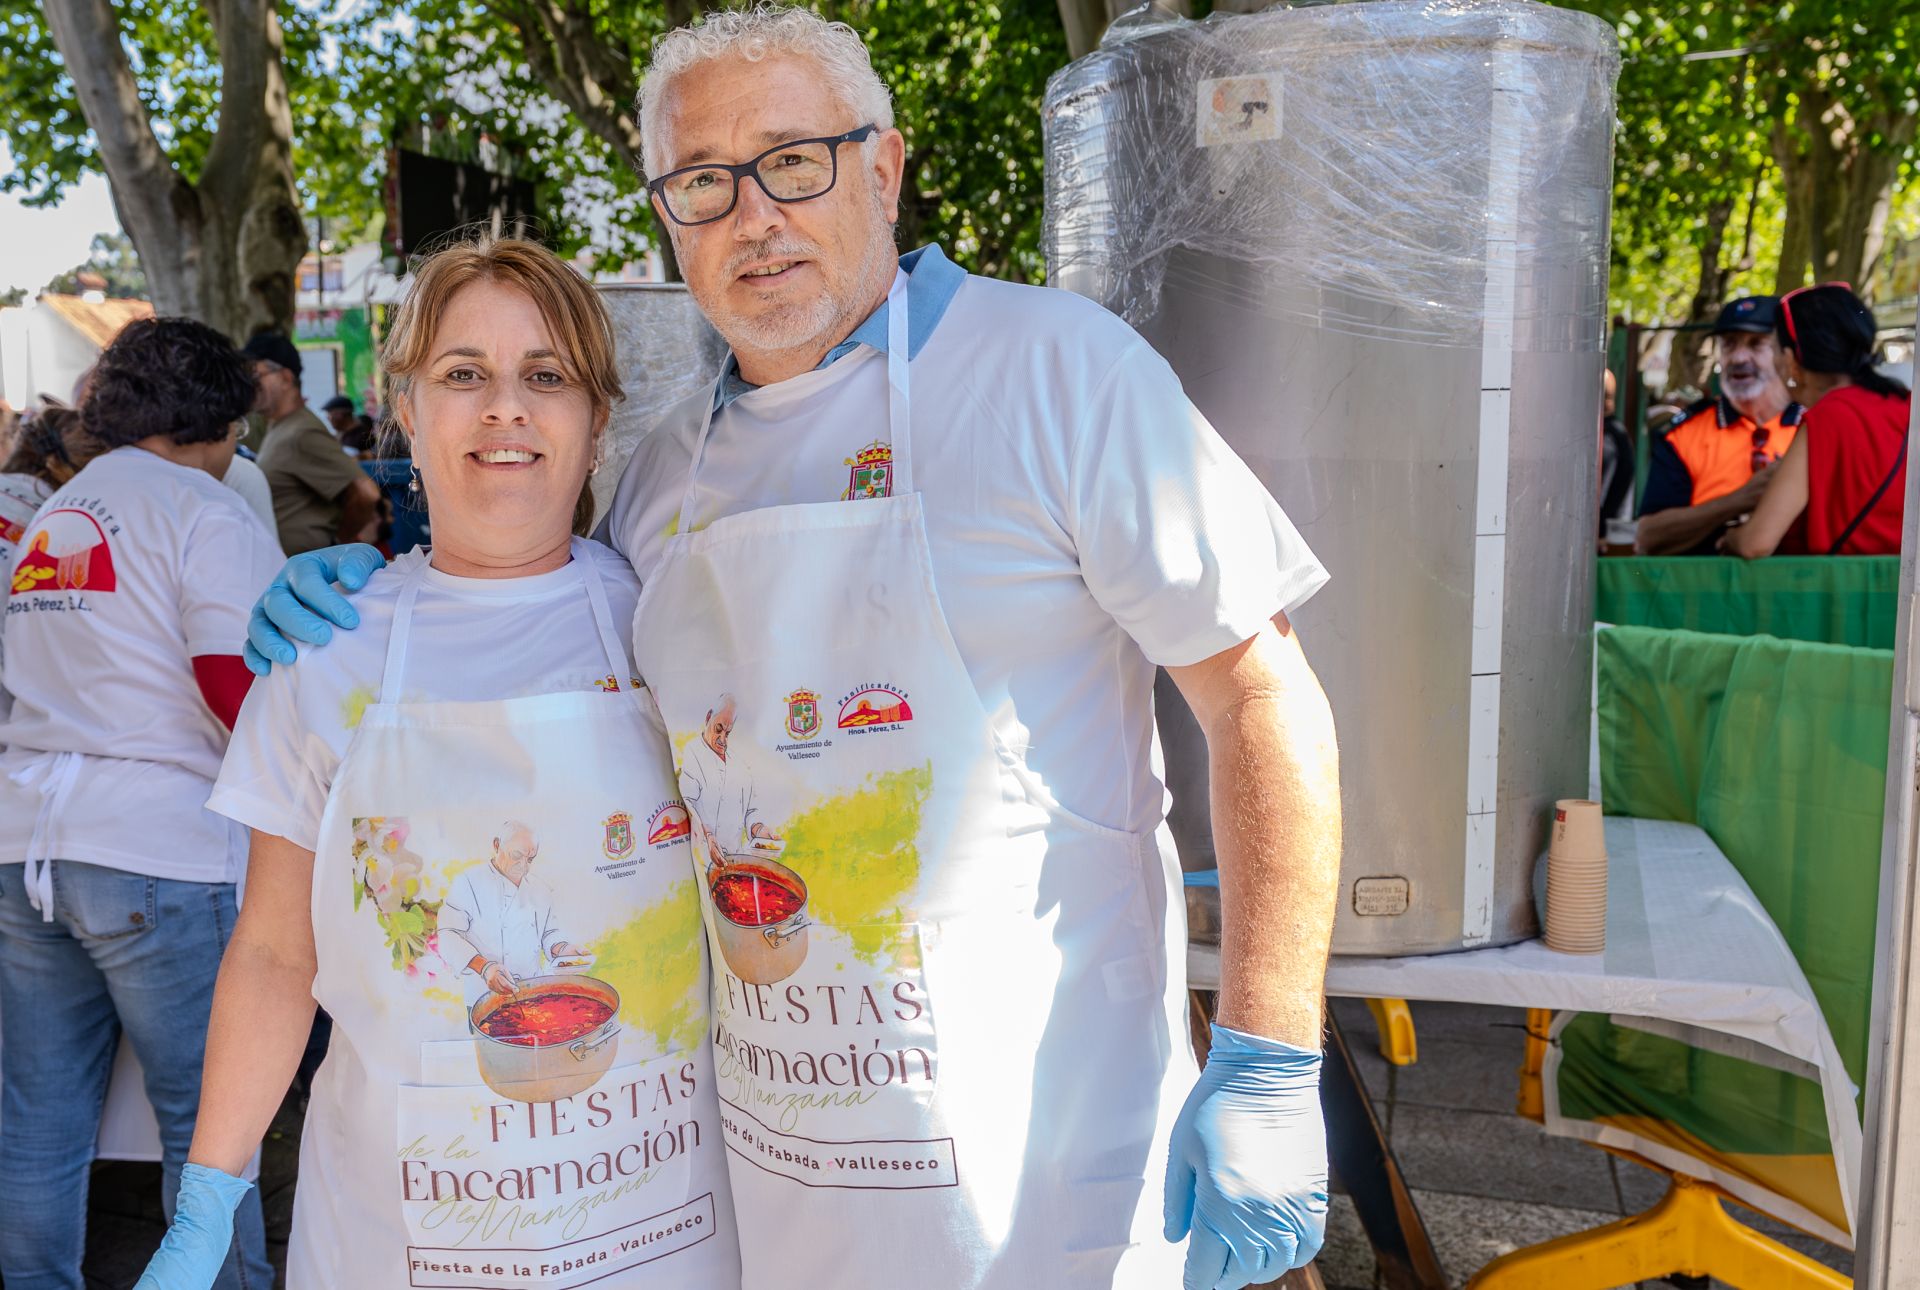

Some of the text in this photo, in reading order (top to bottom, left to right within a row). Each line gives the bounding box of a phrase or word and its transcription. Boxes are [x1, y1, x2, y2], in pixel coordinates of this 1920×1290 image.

[838, 683, 908, 706] Panificadora
[776, 740, 822, 752] Ayuntamiento
[868, 726, 890, 734] Pérez,
[788, 752, 820, 760] Valleseco
[594, 859, 638, 873] Ayuntamiento
[606, 869, 636, 880] Valleseco
[725, 973, 923, 1026] FIESTAS
[490, 1062, 697, 1142] FIESTAS
[731, 1064, 878, 1131] Manzana
[396, 1134, 480, 1161] de la
[401, 1119, 701, 1203] Encarnación
[742, 1128, 753, 1143] de
[757, 1136, 765, 1152] la
[768, 1145, 820, 1170] Fabada
[834, 1157, 939, 1170] Valleseco
[452, 1165, 663, 1248] Manzana
[411, 1214, 704, 1277] Fiesta de la Fabada Valleseco
